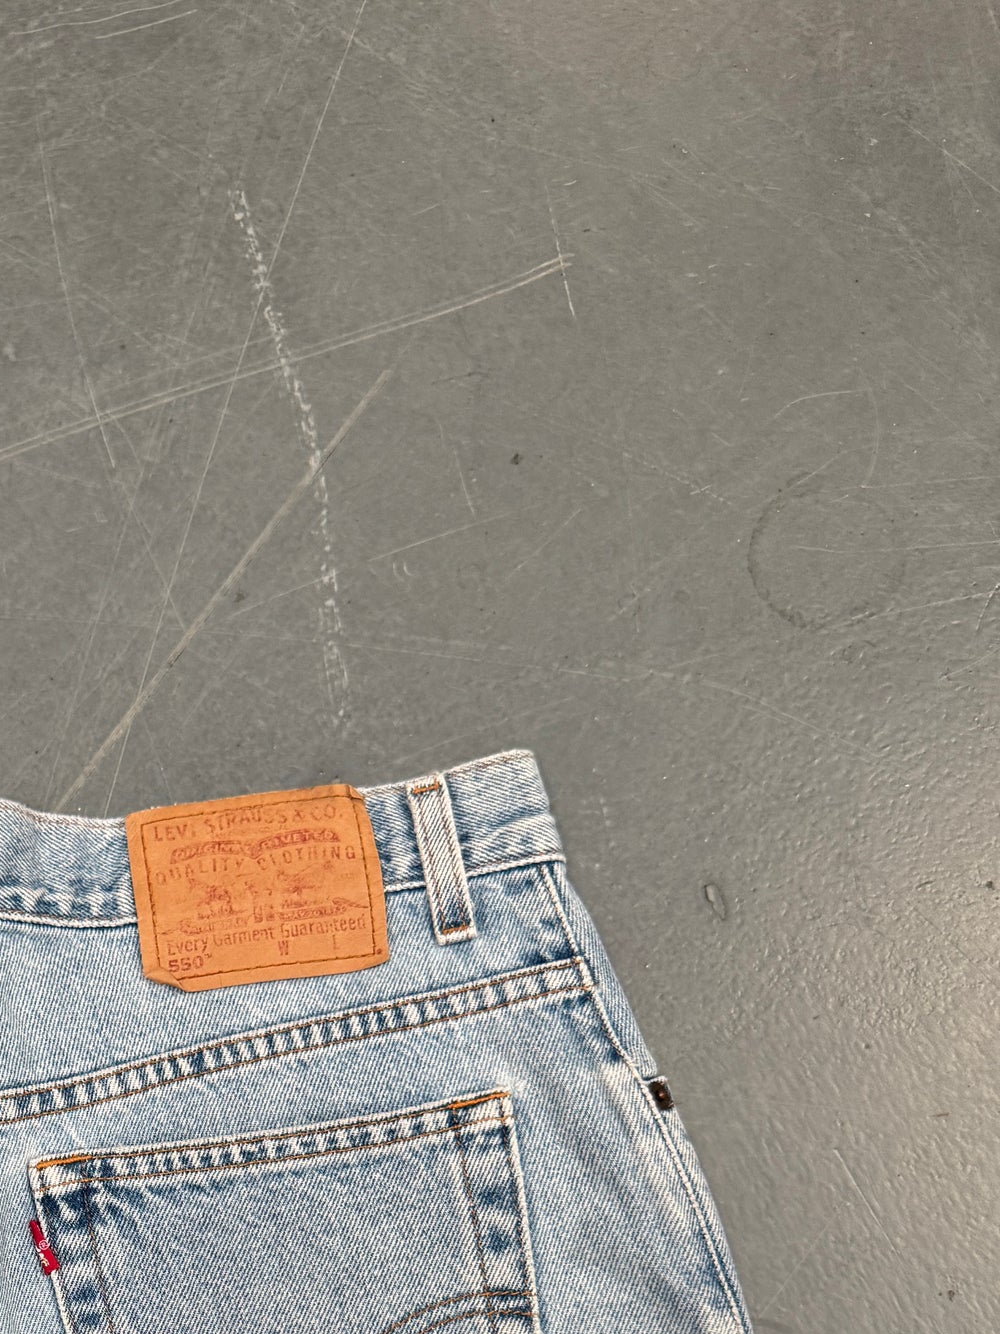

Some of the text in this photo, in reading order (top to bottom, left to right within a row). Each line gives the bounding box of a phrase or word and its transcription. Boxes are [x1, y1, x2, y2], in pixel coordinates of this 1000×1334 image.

[155, 844, 356, 886] QUALITY CLOTHING
[166, 936, 209, 956] Every
[212, 926, 276, 947] Garment
[280, 913, 366, 939] Guaranteed
[277, 940, 290, 956] W
